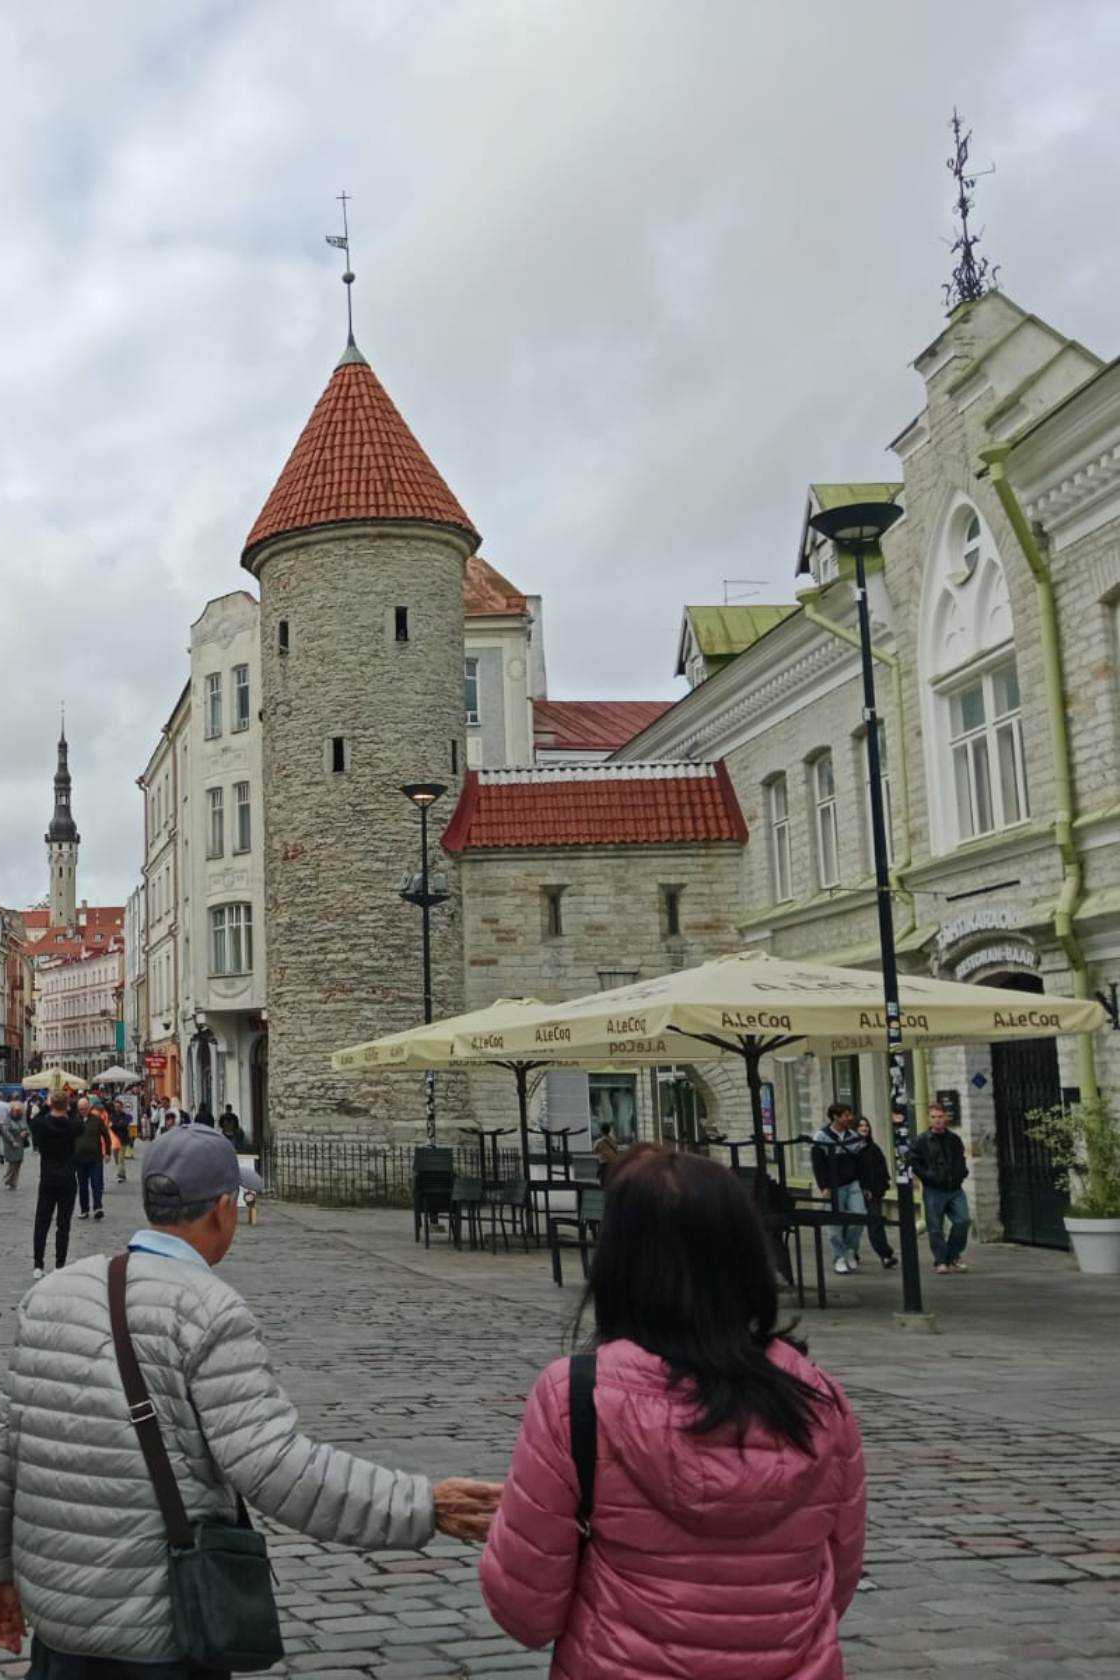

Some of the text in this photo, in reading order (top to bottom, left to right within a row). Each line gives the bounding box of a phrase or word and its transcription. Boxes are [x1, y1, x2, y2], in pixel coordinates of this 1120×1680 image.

[607, 1017, 647, 1034] A.LeCoq
[722, 1012, 791, 1031] A.LeCoq
[994, 1011, 1061, 1030] A.LeCoq
[535, 1027, 570, 1043] A.LeCoq
